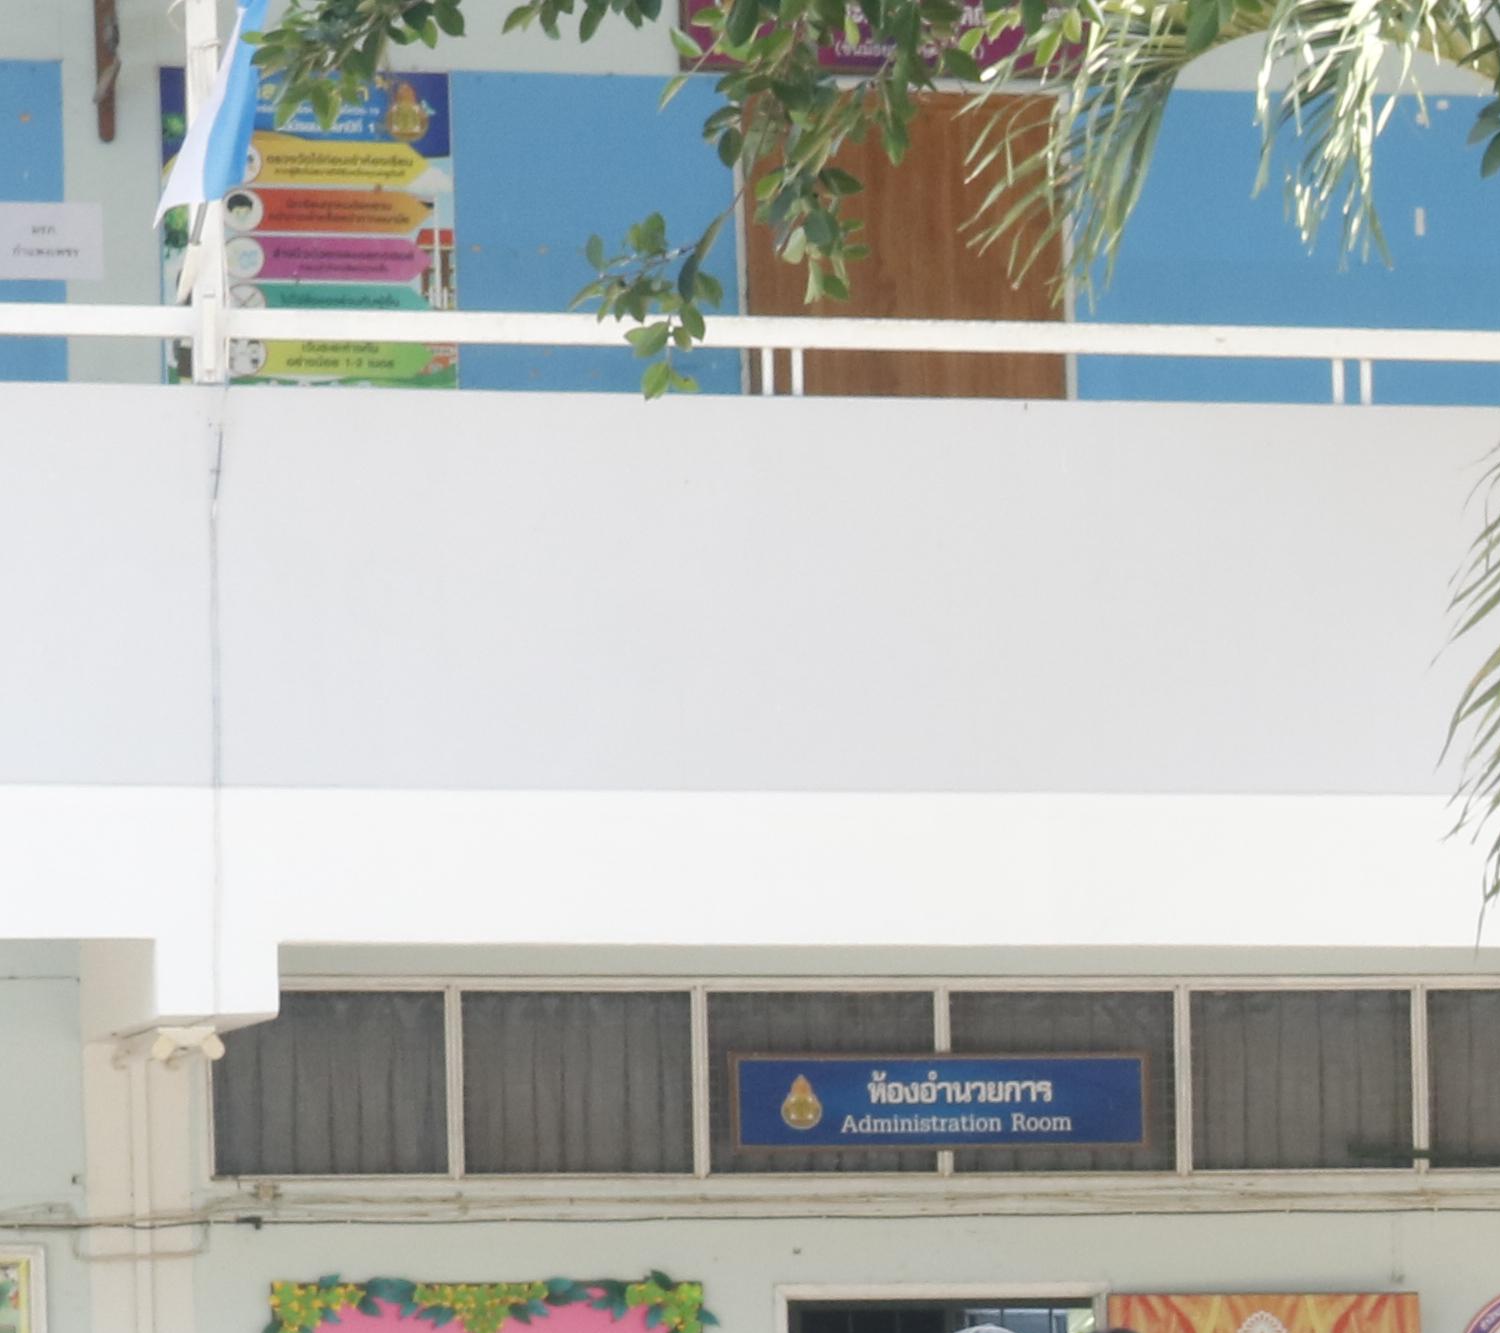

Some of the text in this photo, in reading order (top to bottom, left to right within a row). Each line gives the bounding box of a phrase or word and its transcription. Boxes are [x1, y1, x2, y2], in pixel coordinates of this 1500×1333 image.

[868, 1070, 1053, 1104] ห้องอำนวยการ
[841, 1113, 1072, 1134] Administration Room
